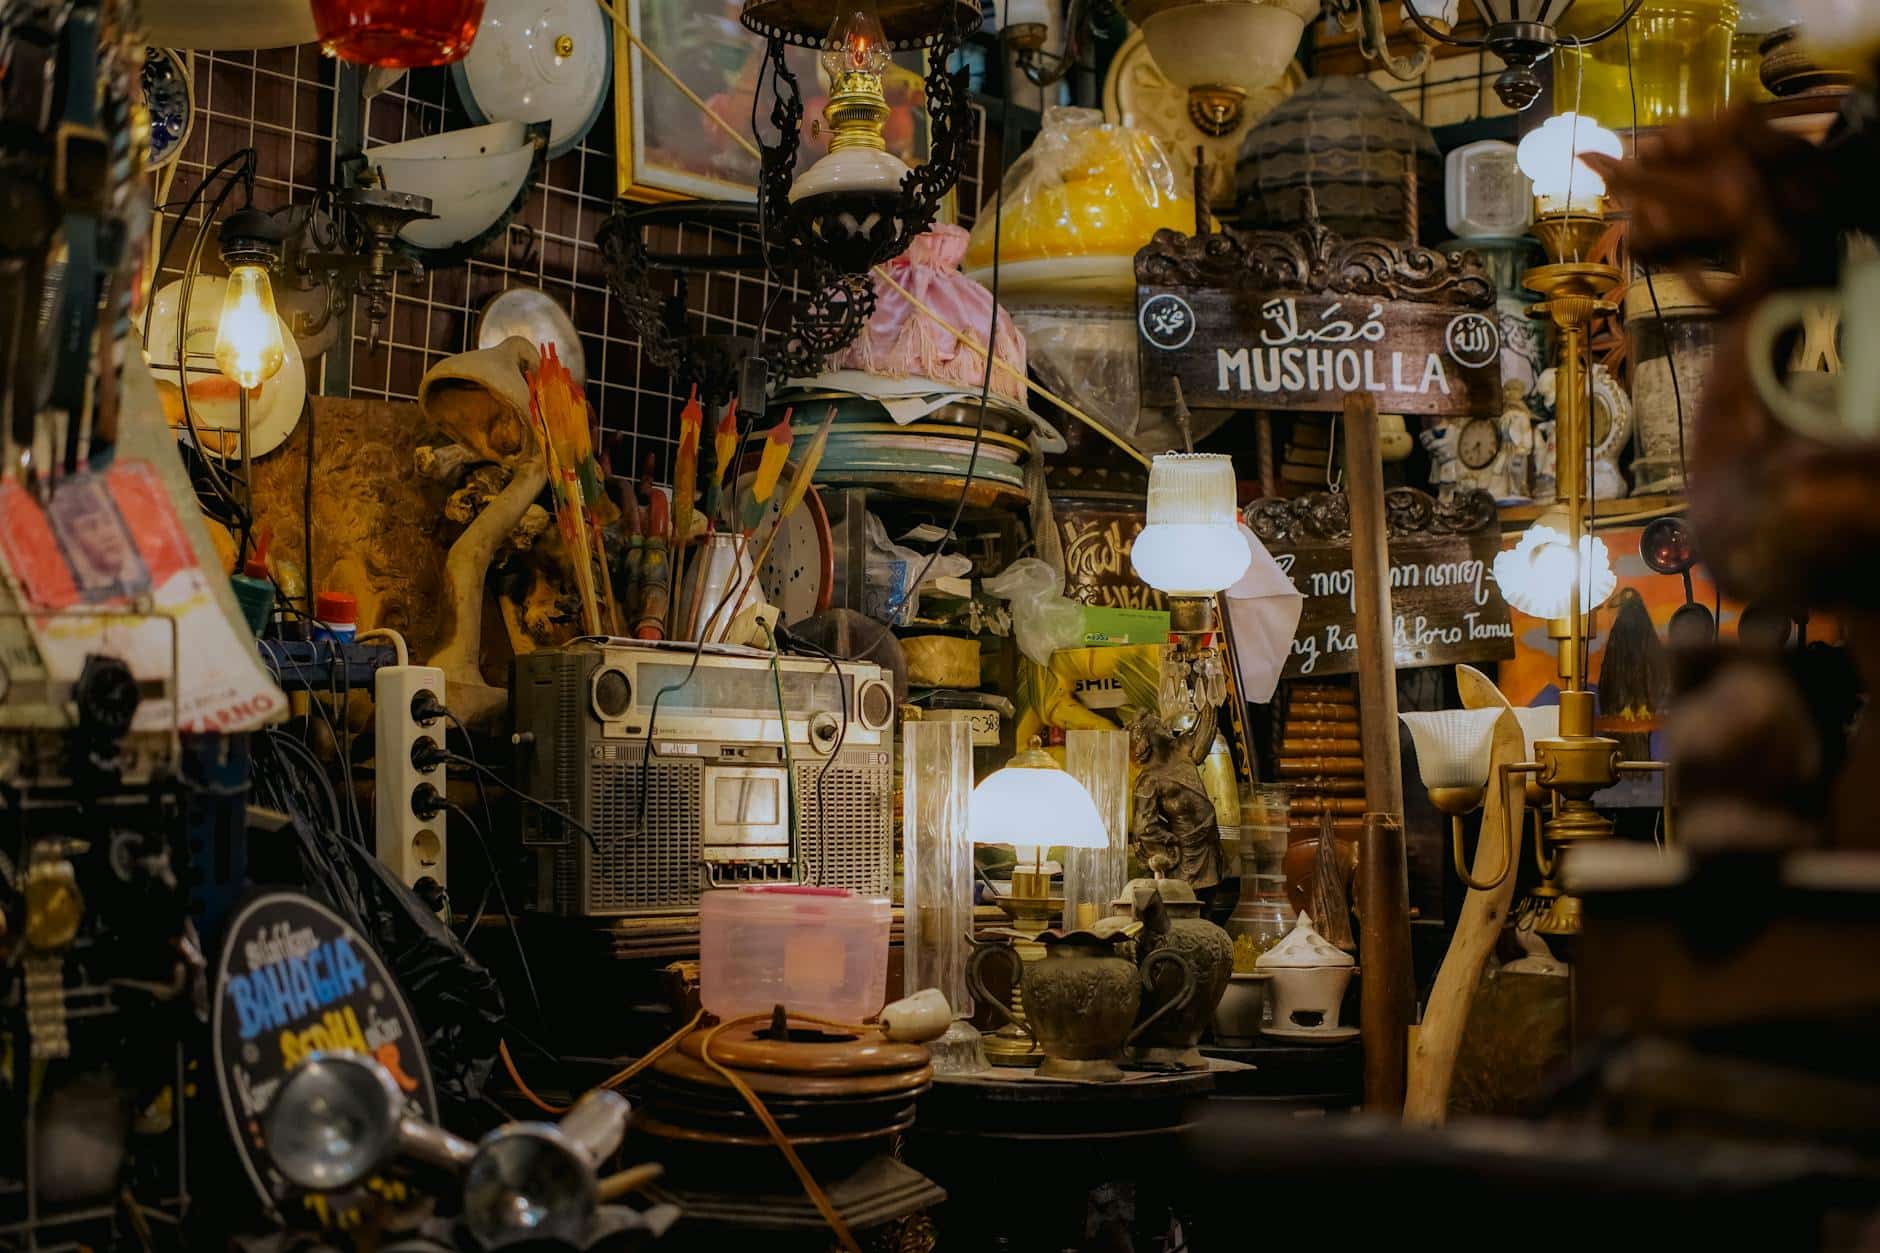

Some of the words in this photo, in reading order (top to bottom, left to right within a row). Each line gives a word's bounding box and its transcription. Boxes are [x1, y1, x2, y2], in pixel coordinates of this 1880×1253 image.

[1217, 347, 1450, 395] MUSHOLLA
[1464, 612, 1513, 641] Tamu
[228, 937, 367, 1038] BAHAGIA
